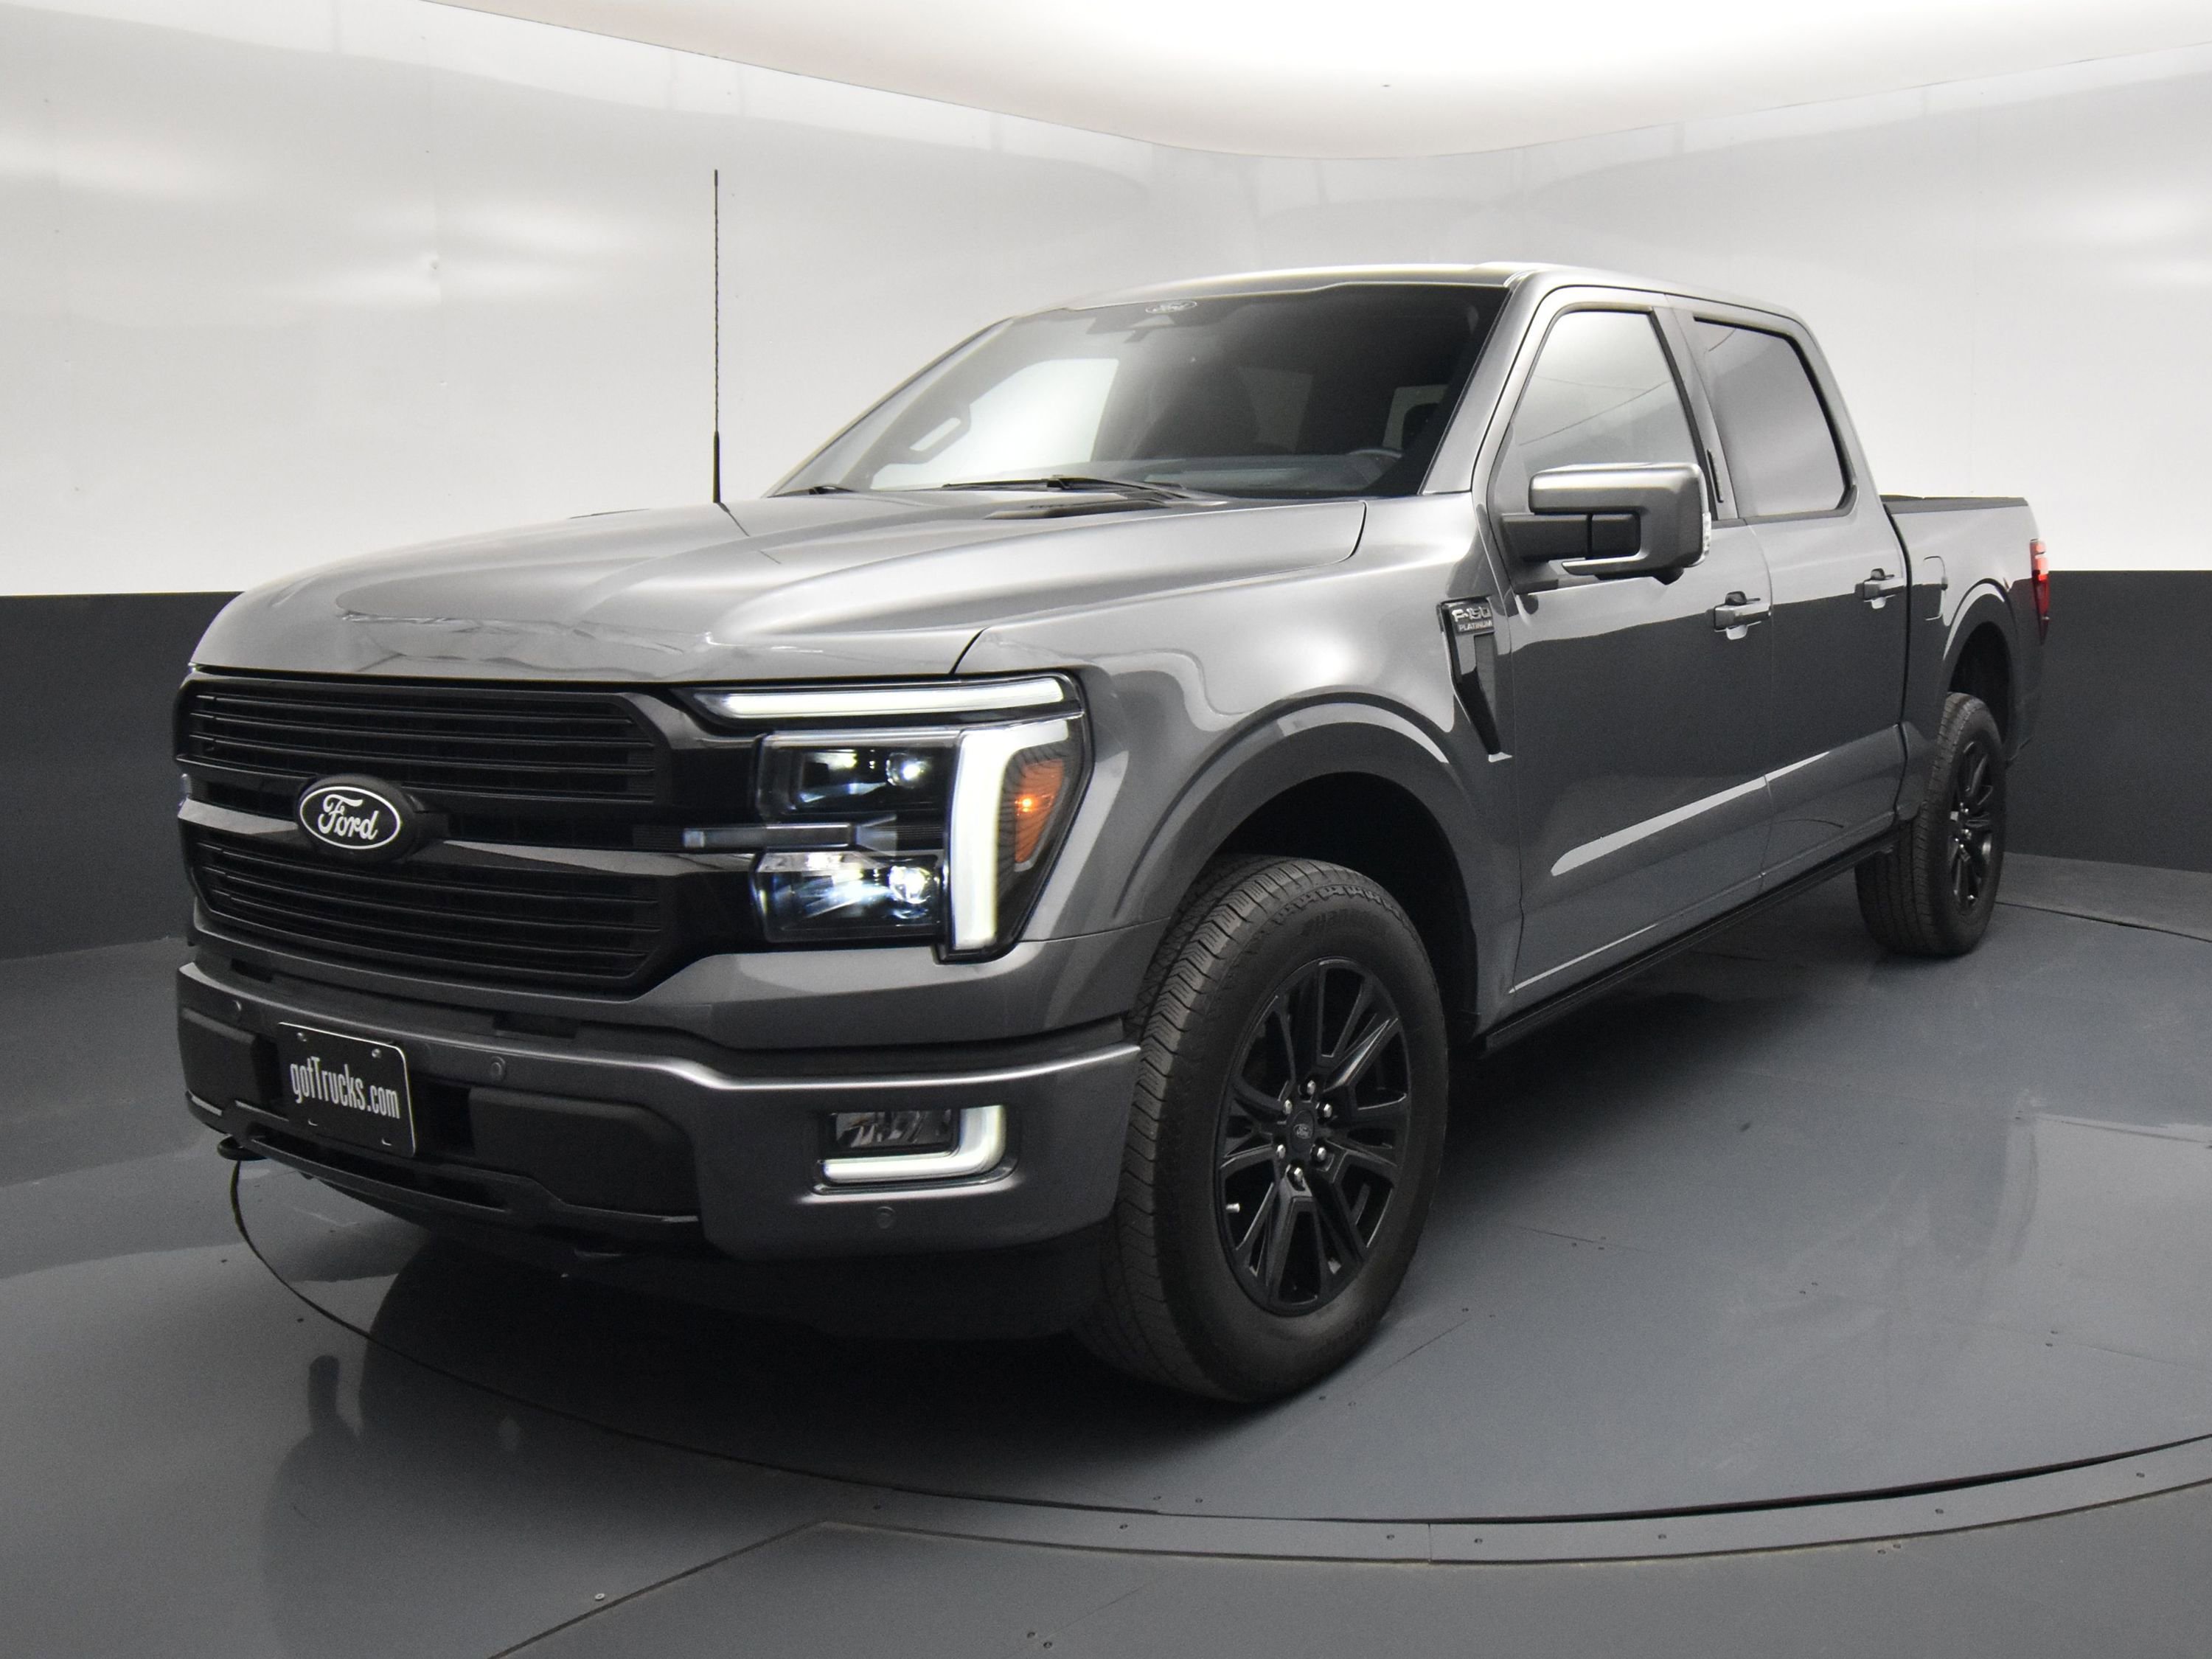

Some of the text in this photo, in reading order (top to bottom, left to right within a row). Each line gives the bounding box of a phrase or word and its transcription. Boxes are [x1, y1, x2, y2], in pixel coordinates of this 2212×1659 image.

[1452, 606, 1492, 622] F-150
[1458, 620, 1493, 631] PLATINUM
[318, 793, 379, 841] Ford
[290, 1056, 400, 1119] gotTrucks.com
